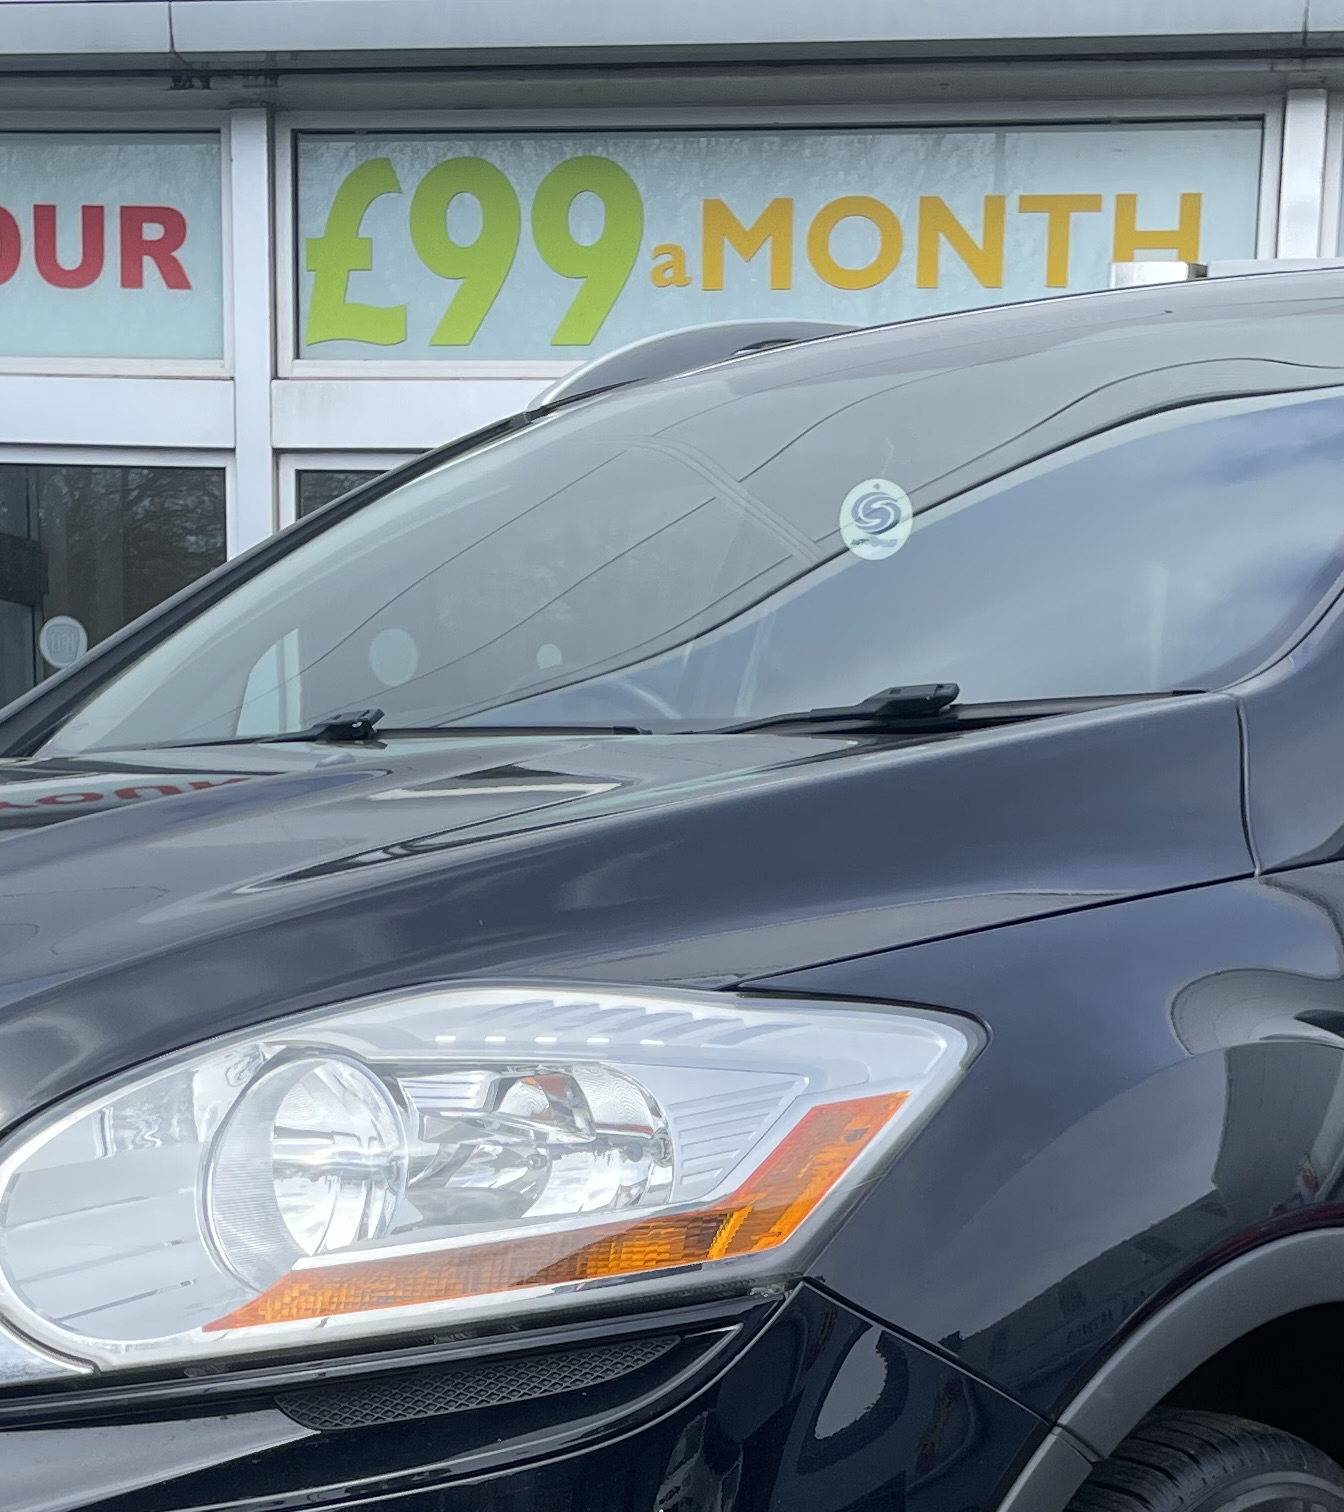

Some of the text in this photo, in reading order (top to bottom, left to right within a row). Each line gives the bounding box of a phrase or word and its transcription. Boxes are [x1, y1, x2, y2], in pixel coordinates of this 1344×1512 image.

[305, 156, 1203, 346] £99 a MONTH
